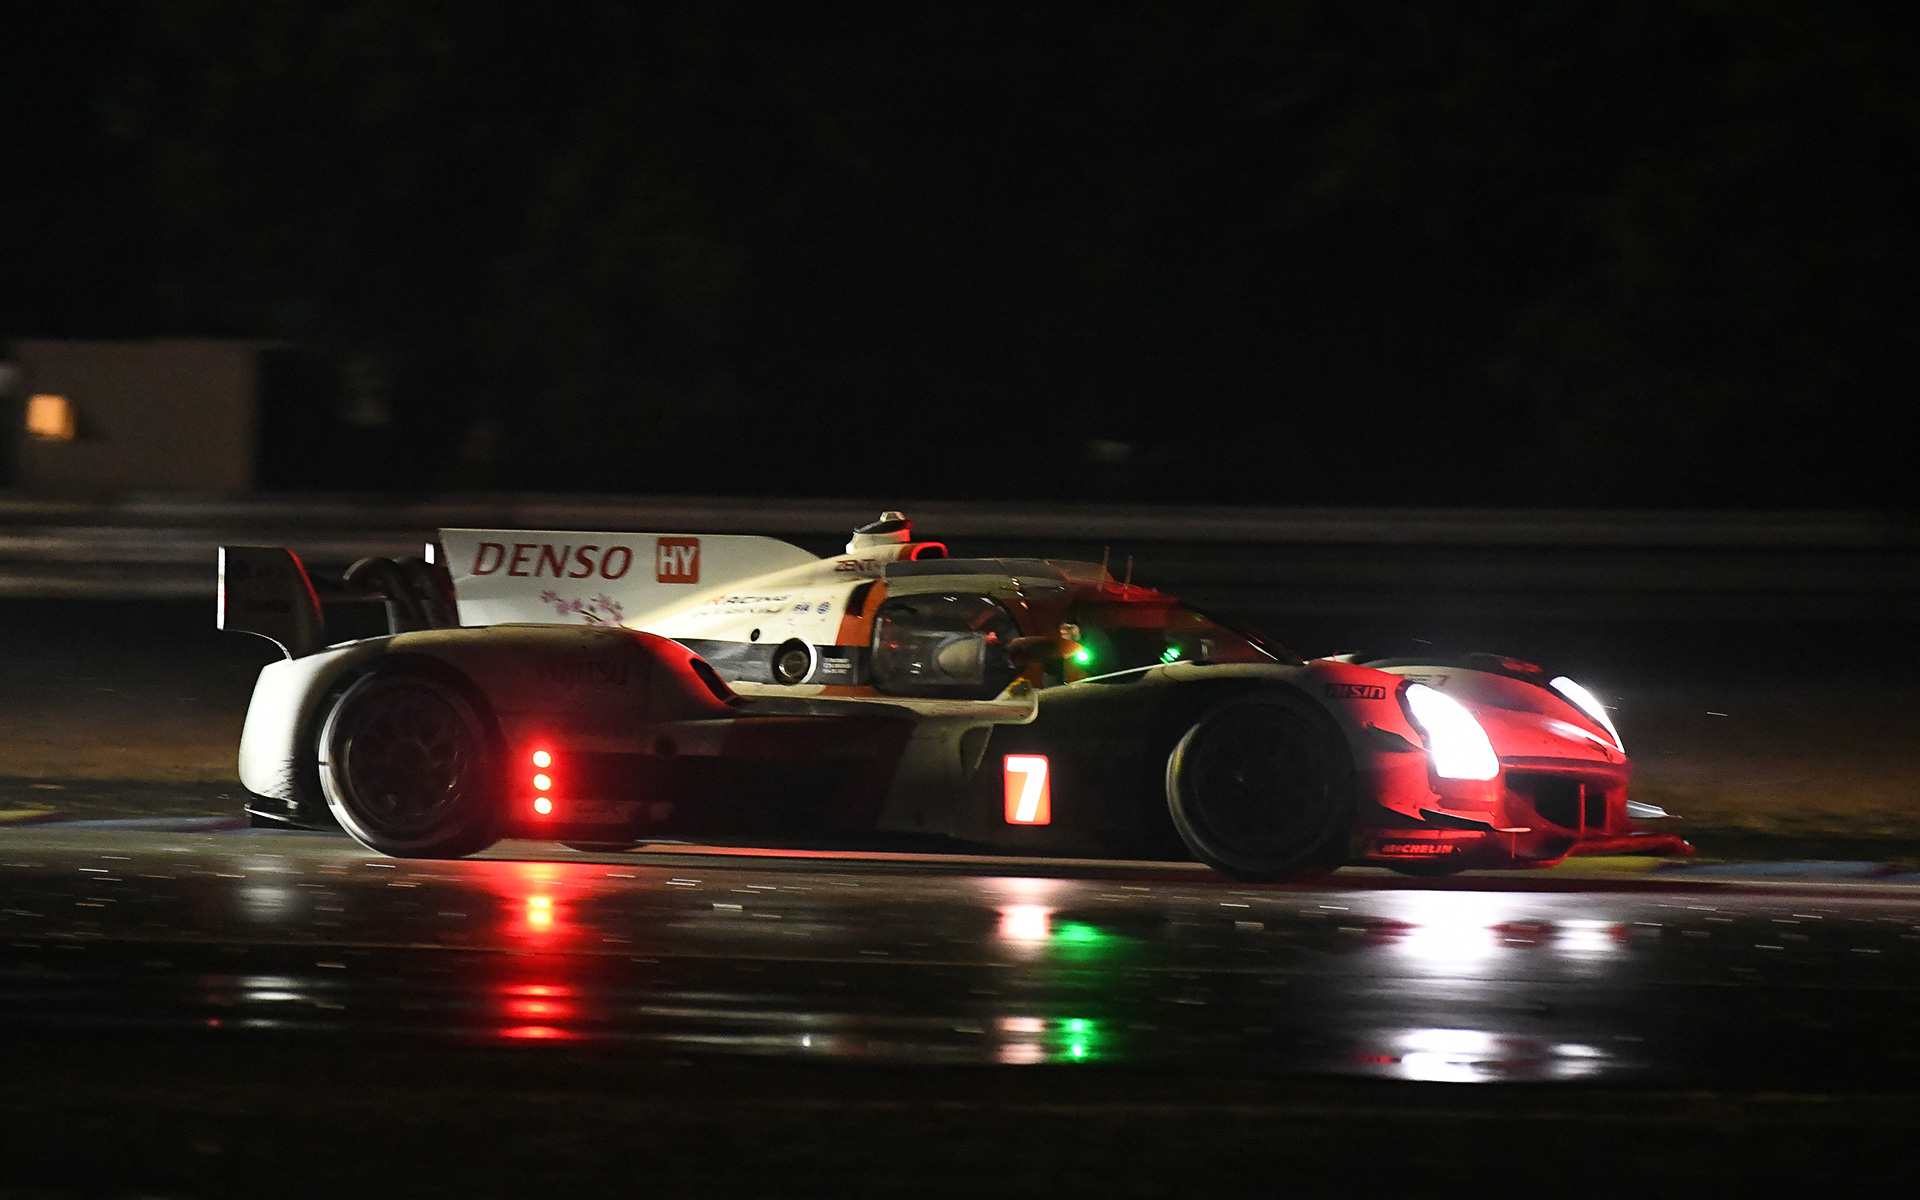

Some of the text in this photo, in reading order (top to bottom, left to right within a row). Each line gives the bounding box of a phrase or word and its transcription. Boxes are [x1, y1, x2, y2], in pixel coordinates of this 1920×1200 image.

[471, 542, 696, 581] DENSO HY
[1006, 756, 1048, 822] 7
